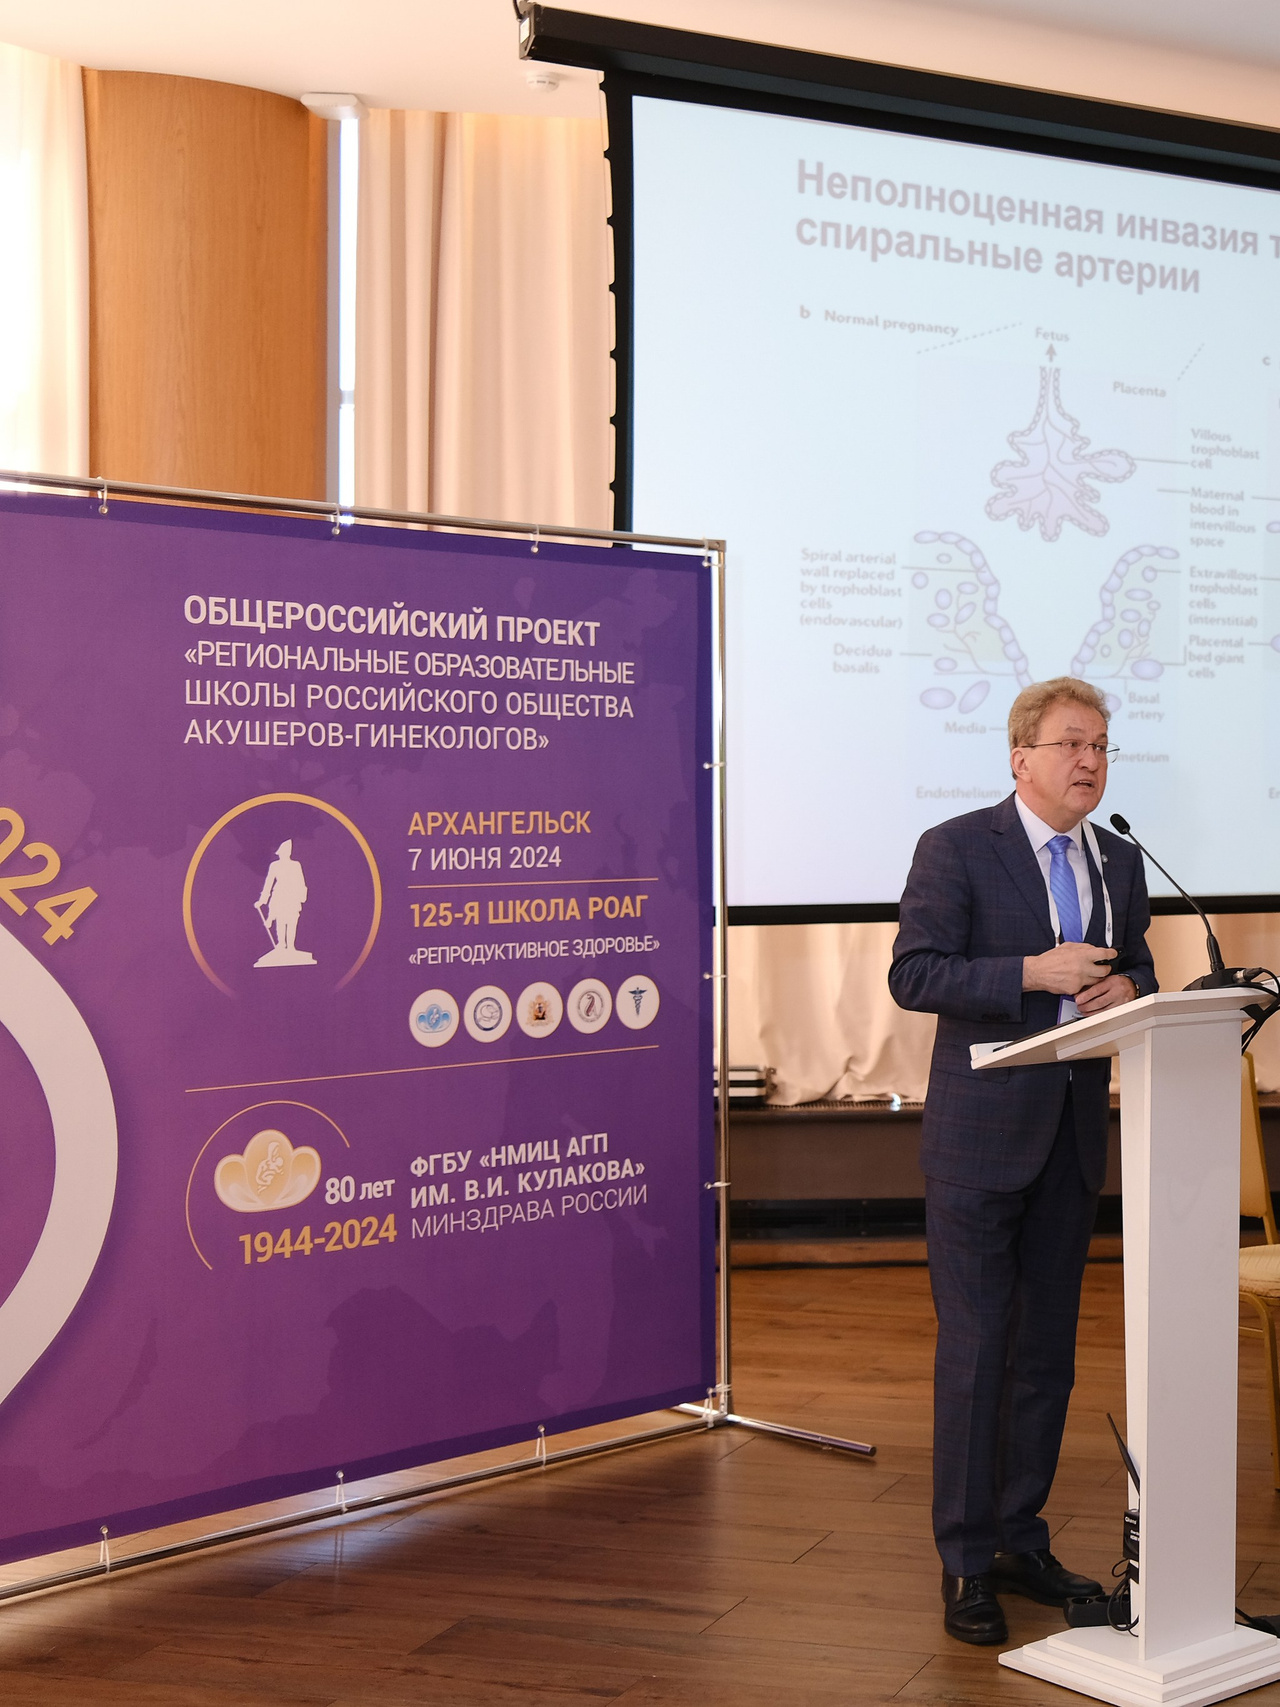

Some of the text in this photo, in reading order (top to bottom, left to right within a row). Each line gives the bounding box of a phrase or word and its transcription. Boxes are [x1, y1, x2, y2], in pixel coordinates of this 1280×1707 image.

[797, 158, 1105, 236] Неполноценная
[1115, 201, 1259, 257] инвазия
[795, 212, 1201, 296] спиральные артерии
[799, 304, 959, 338] b Normal pregnancy
[1035, 326, 1071, 343] Fetus
[1112, 380, 1167, 398] Placenta
[1191, 427, 1232, 443] Villous
[1191, 444, 1260, 460] trophoblast
[1190, 458, 1213, 470] cell
[1190, 486, 1245, 502] Maternal
[1190, 502, 1240, 517] blood in
[1190, 519, 1256, 534] intervillous
[1190, 536, 1225, 549] space
[800, 548, 897, 566] Spiral arterial
[800, 565, 896, 582] wall replaced
[1189, 566, 1258, 582] Extravillous
[800, 581, 902, 598] by trophoblast
[1189, 582, 1258, 597] trophoblast
[800, 597, 833, 610] cells
[1188, 598, 1217, 610] cells
[184, 595, 600, 647] ОБЩЕРОССИЙСКИЙ ПРОЕКТ
[799, 613, 903, 630] (endovascular)
[1188, 613, 1258, 629] (interstitial)
[1188, 634, 1245, 648] Placental
[833, 642, 894, 658] Decidua
[1188, 650, 1245, 666] bed giant
[185, 640, 635, 685] «РЕГИОНАЛЬНЫЕ ОБРАЗОВАТЕЛЬНЫЕ
[832, 660, 881, 674] basalis
[1188, 666, 1217, 679] cells
[184, 679, 634, 719] ШКОЛЫ РОССИЙСКОГО ОБЩЕСТВА
[1127, 691, 1161, 704] Basal
[1127, 710, 1166, 724] artery
[184, 719, 550, 750] АКУШЕРОВ-ГИНЕКОЛОГОВ»
[944, 720, 987, 734] Media
[915, 785, 1003, 801] Endothelium
[408, 810, 591, 837] АРХАНГЕЛЬСК
[408, 845, 561, 871] 7 ИЮНЯ 2024
[410, 893, 649, 928] 125-Я ШКОЛА РОАГ
[408, 935, 661, 966] «РЕПРОДУКТИВНОЕ ЗДОРОВЬЕ»
[410, 1132, 608, 1179] ФГБУ «НМИЦ АГП
[325, 1175, 396, 1206] 80 лет
[410, 1159, 645, 1209] ИМ. В.И. КУЛАКОВА»
[411, 1184, 648, 1240] МИНЗДРАВА РОССИИ
[238, 1213, 398, 1265] 1944-2024
